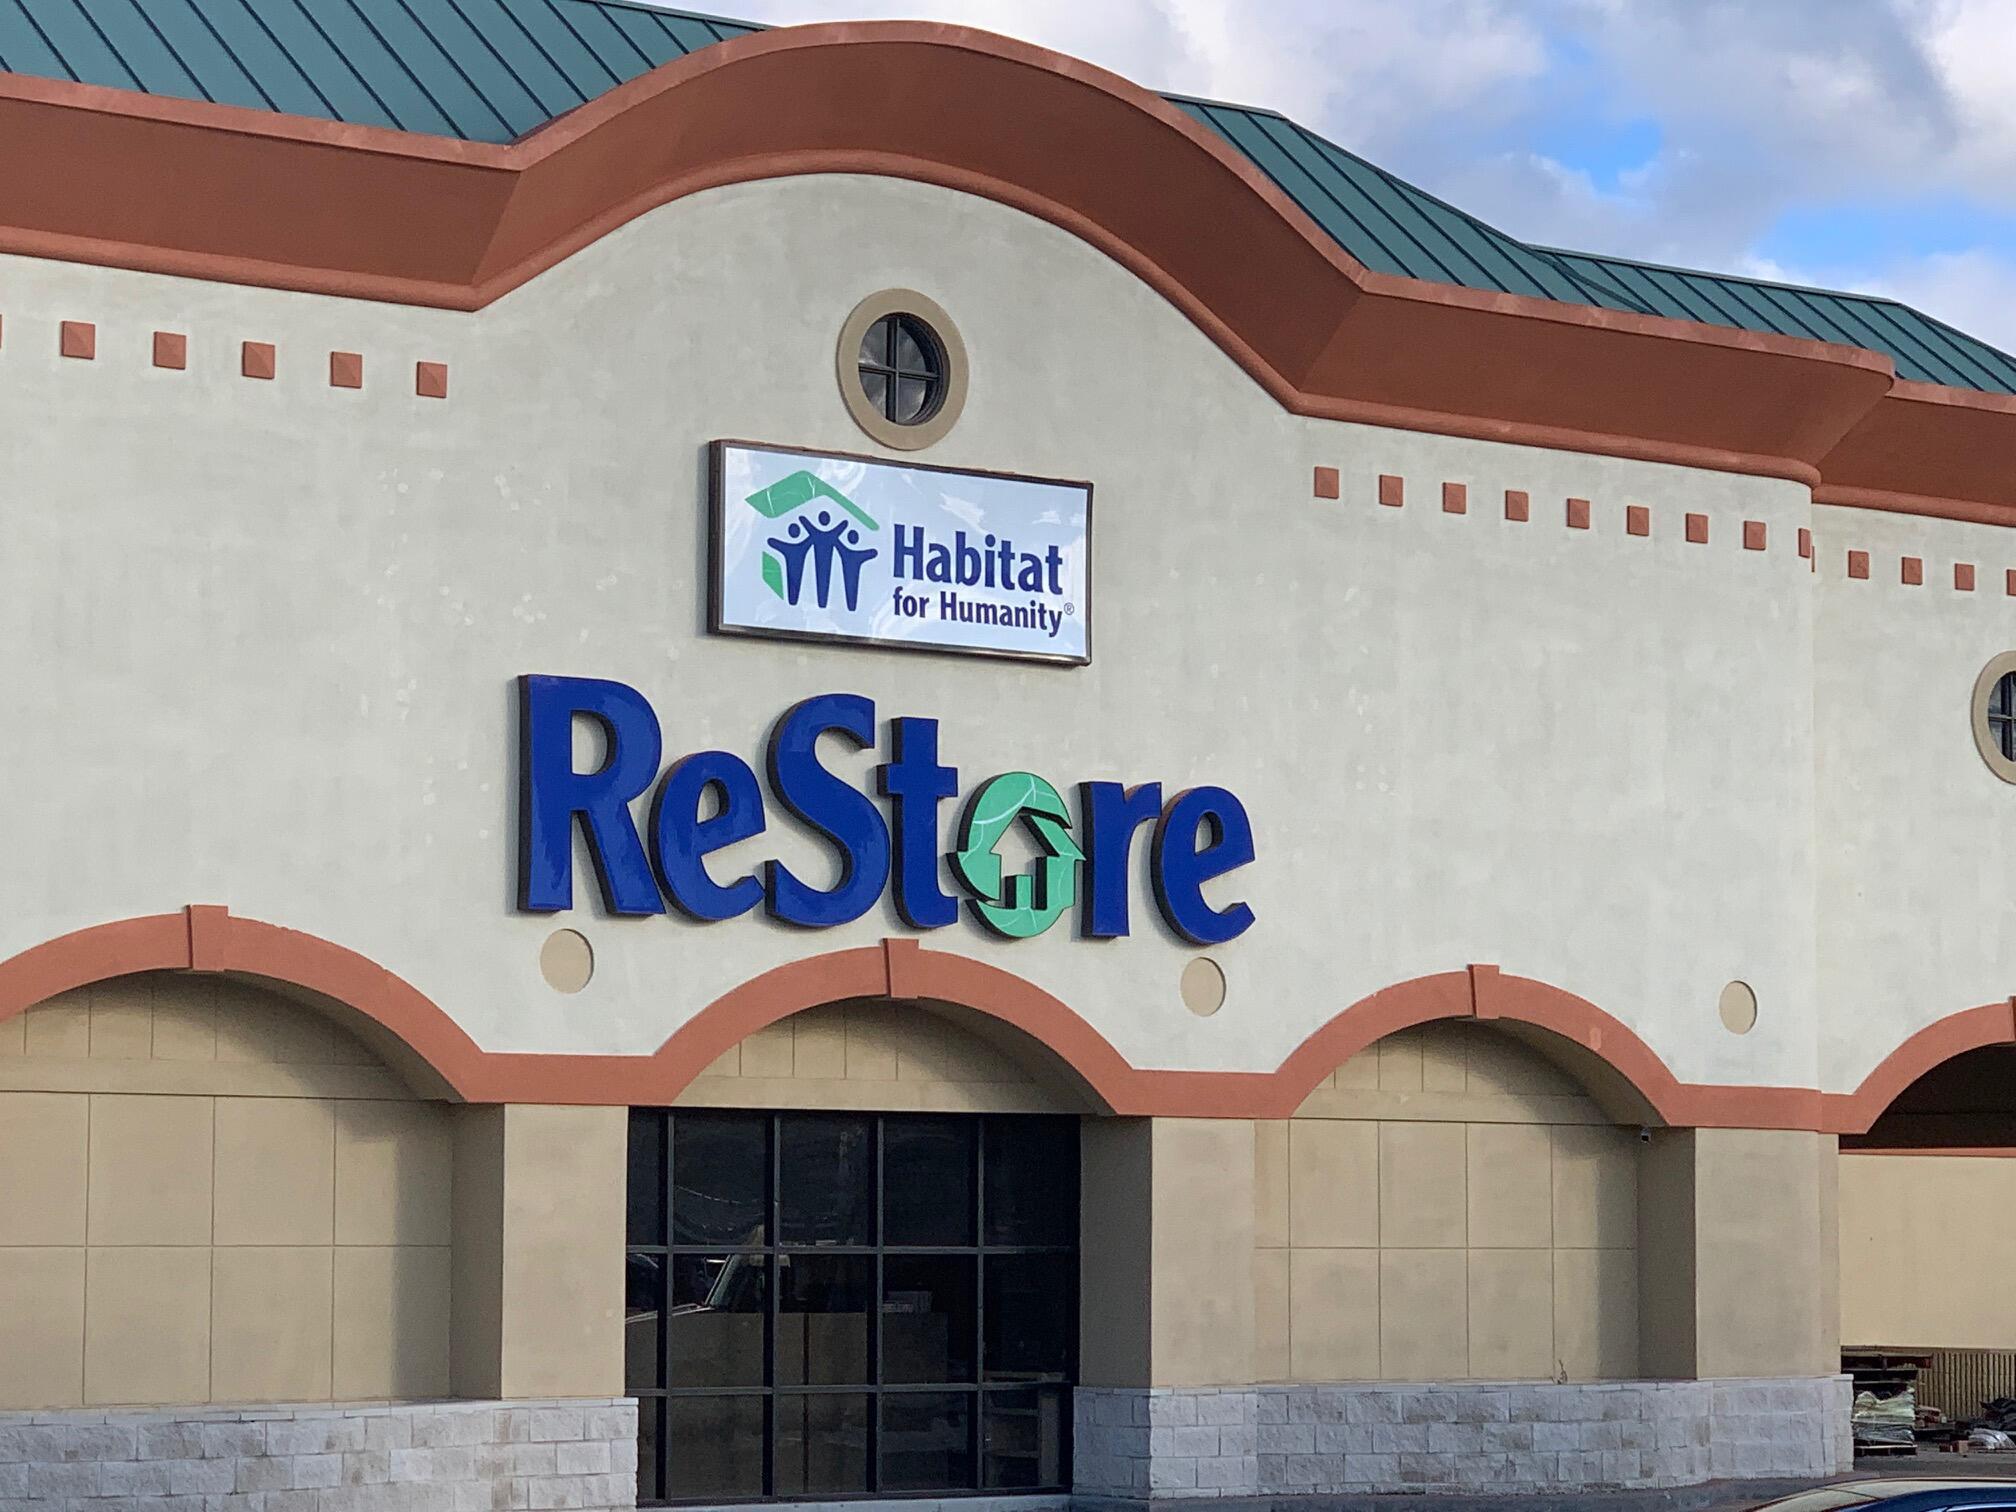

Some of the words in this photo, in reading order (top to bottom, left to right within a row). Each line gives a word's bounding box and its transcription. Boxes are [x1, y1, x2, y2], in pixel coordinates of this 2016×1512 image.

[893, 524, 1063, 595] Habitat
[892, 586, 929, 618] for
[518, 674, 1256, 945] ReStore
